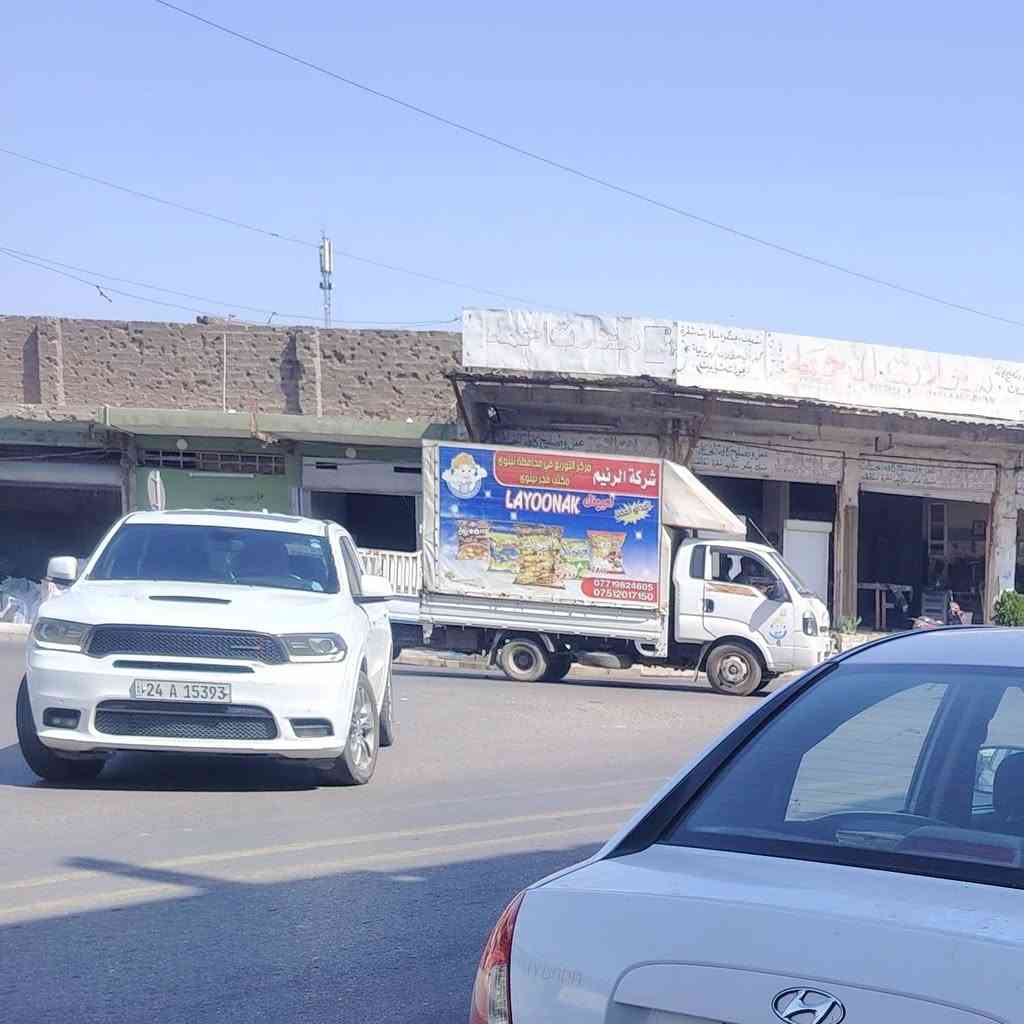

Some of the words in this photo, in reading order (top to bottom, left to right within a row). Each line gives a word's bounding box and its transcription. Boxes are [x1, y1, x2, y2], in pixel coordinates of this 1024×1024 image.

[628, 467, 657, 489] شركة
[505, 489, 581, 515] LAYOONAK
[146, 683, 163, 697] 24
[169, 684, 178, 698] A
[183, 685, 226, 700] 15393
